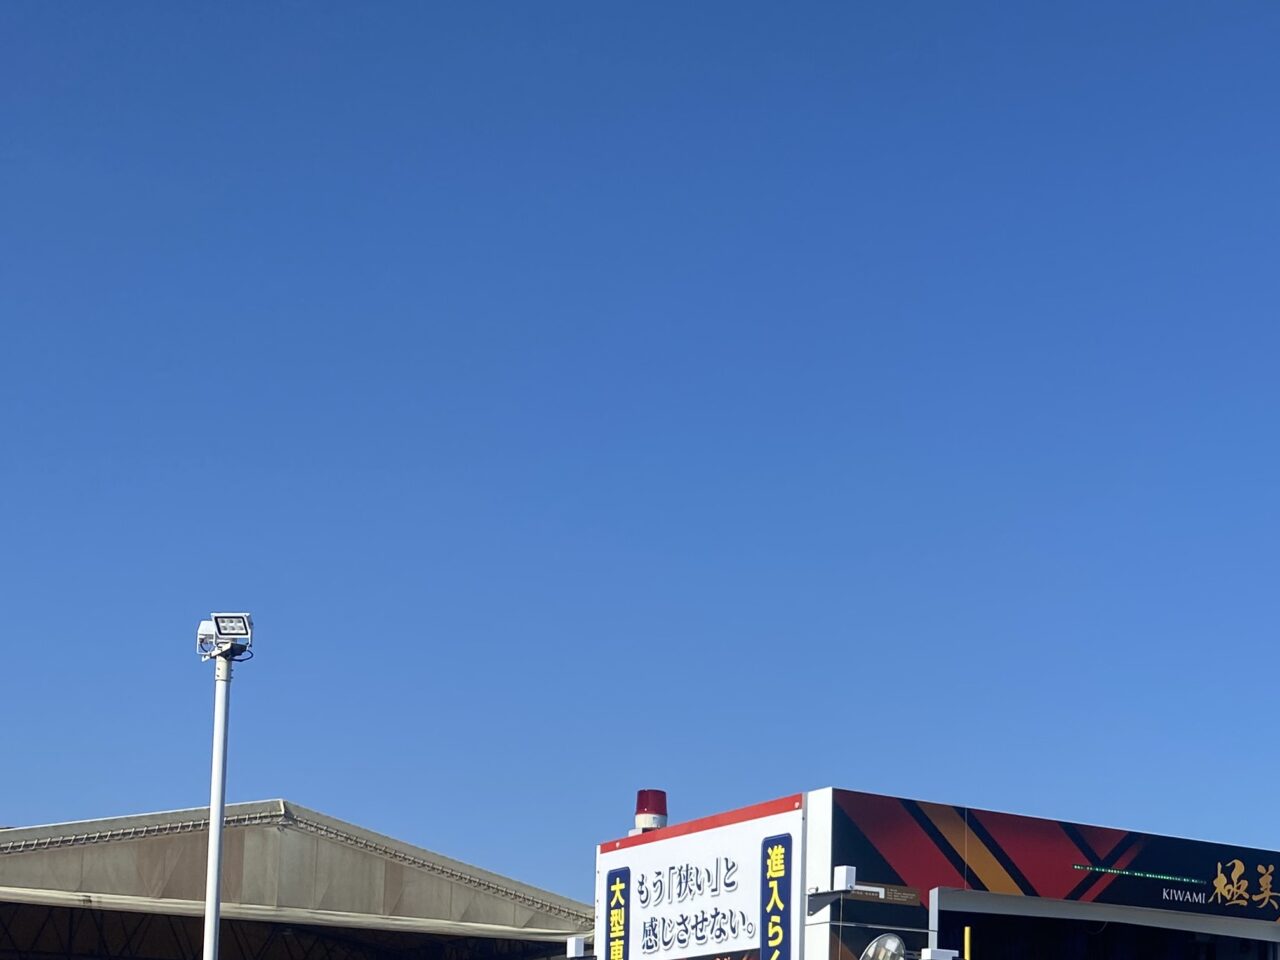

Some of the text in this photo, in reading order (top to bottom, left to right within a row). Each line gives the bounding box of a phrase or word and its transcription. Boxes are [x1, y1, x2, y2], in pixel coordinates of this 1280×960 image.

[636, 857, 739, 907] もう「狭い」と
[1162, 888, 1206, 904] KIWAMI
[641, 908, 756, 953] 感じさせない。
